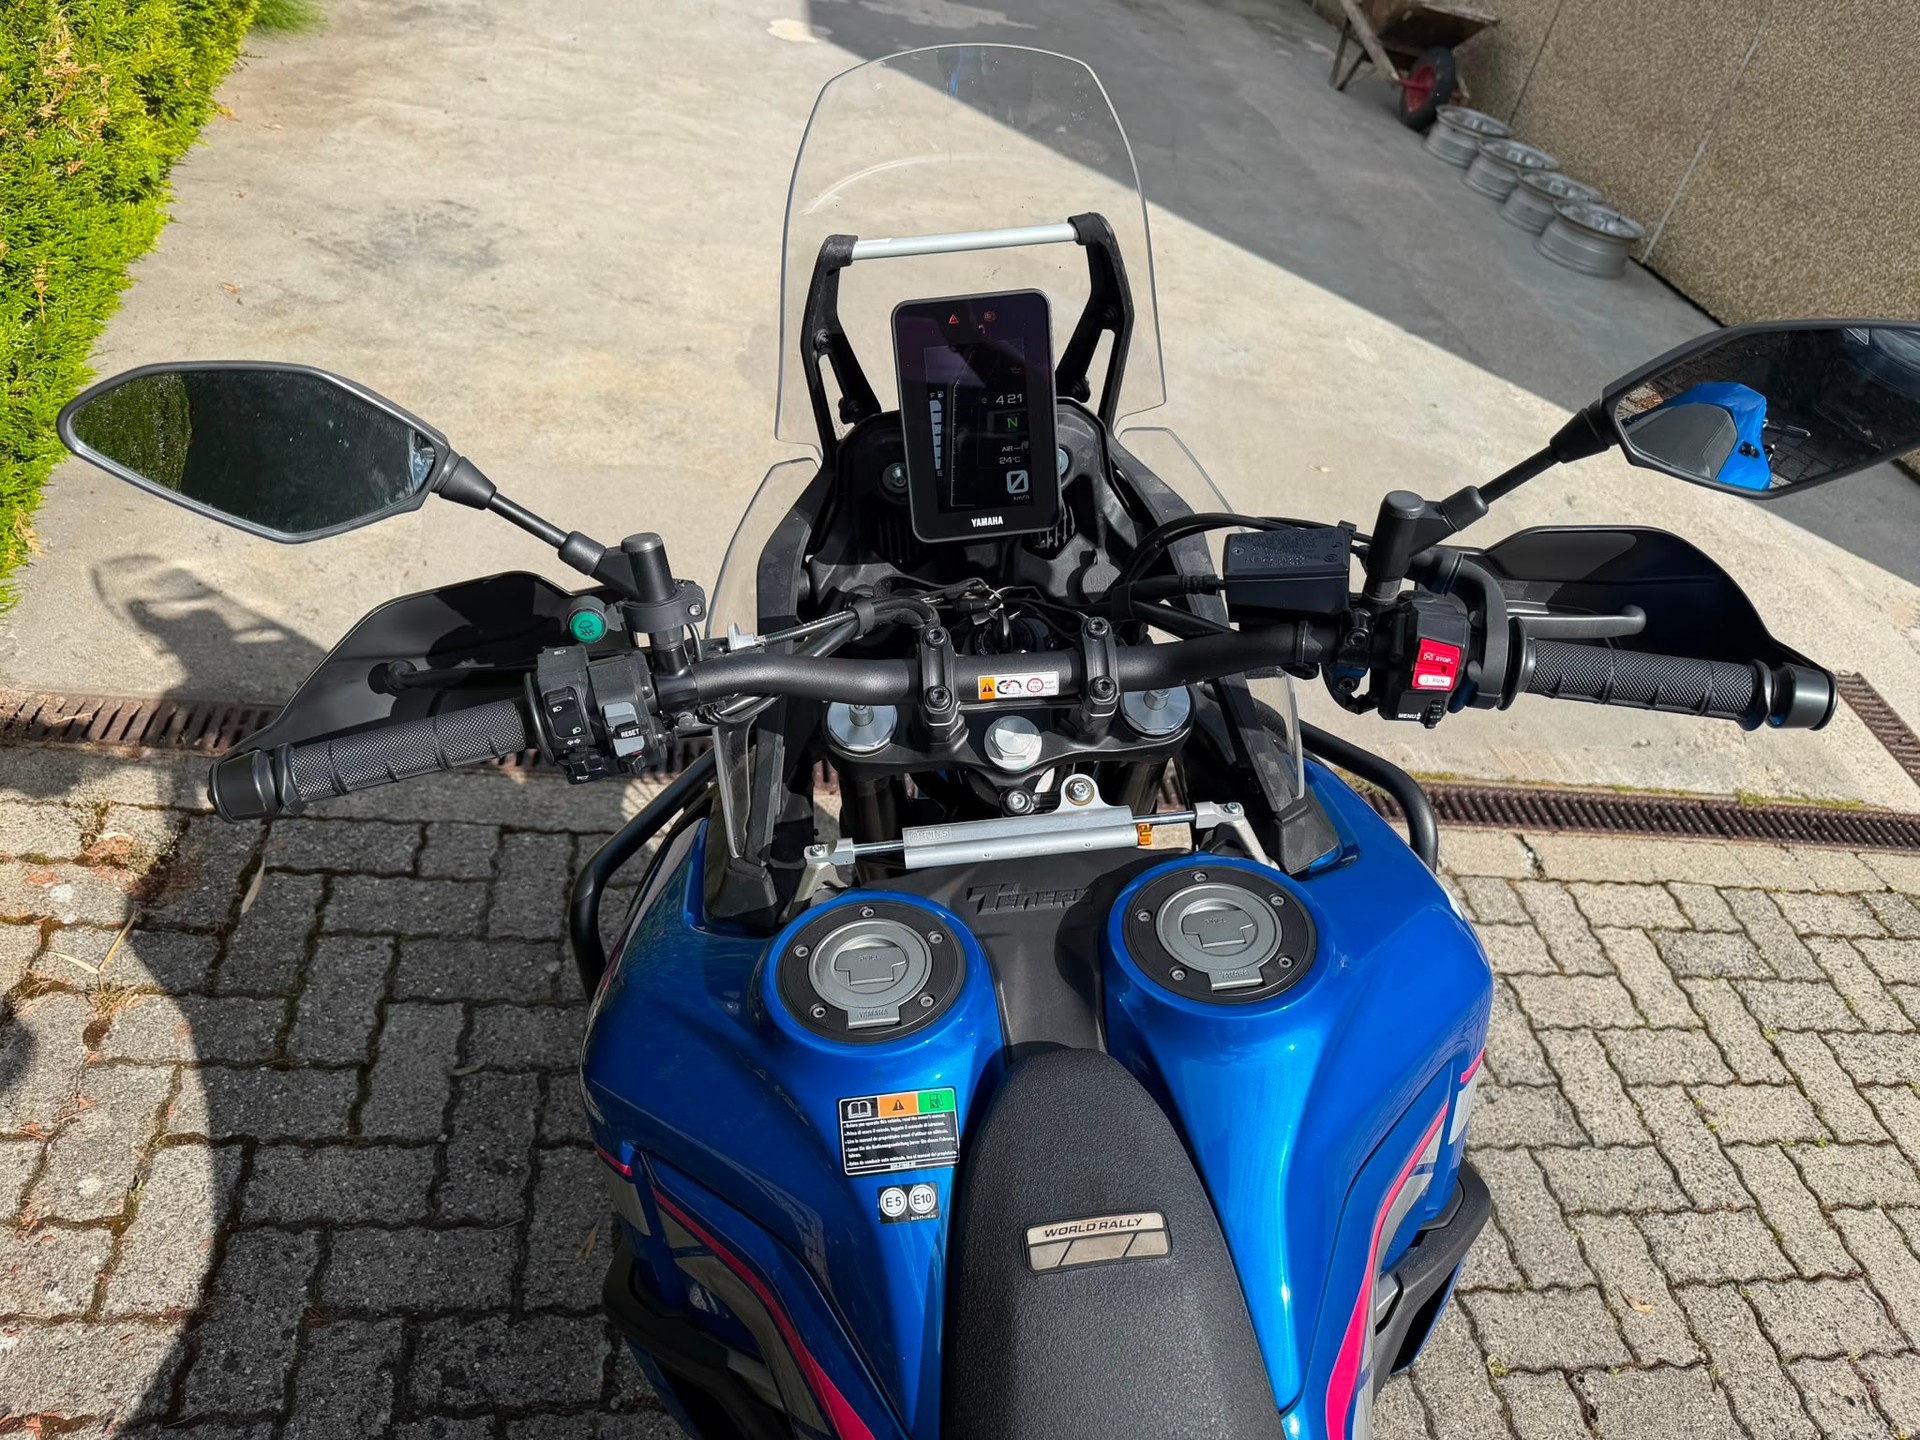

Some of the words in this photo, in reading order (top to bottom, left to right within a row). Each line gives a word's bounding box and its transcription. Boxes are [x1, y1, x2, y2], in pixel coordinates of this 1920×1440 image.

[1007, 417, 1018, 428] N
[971, 516, 1004, 527] YAMAHA
[620, 728, 640, 738] RESET
[859, 1008, 888, 1017] YAMAHA
[914, 1194, 931, 1205] E10
[1044, 1223, 1095, 1237] WORLD
[1099, 1218, 1143, 1230] RALLY
